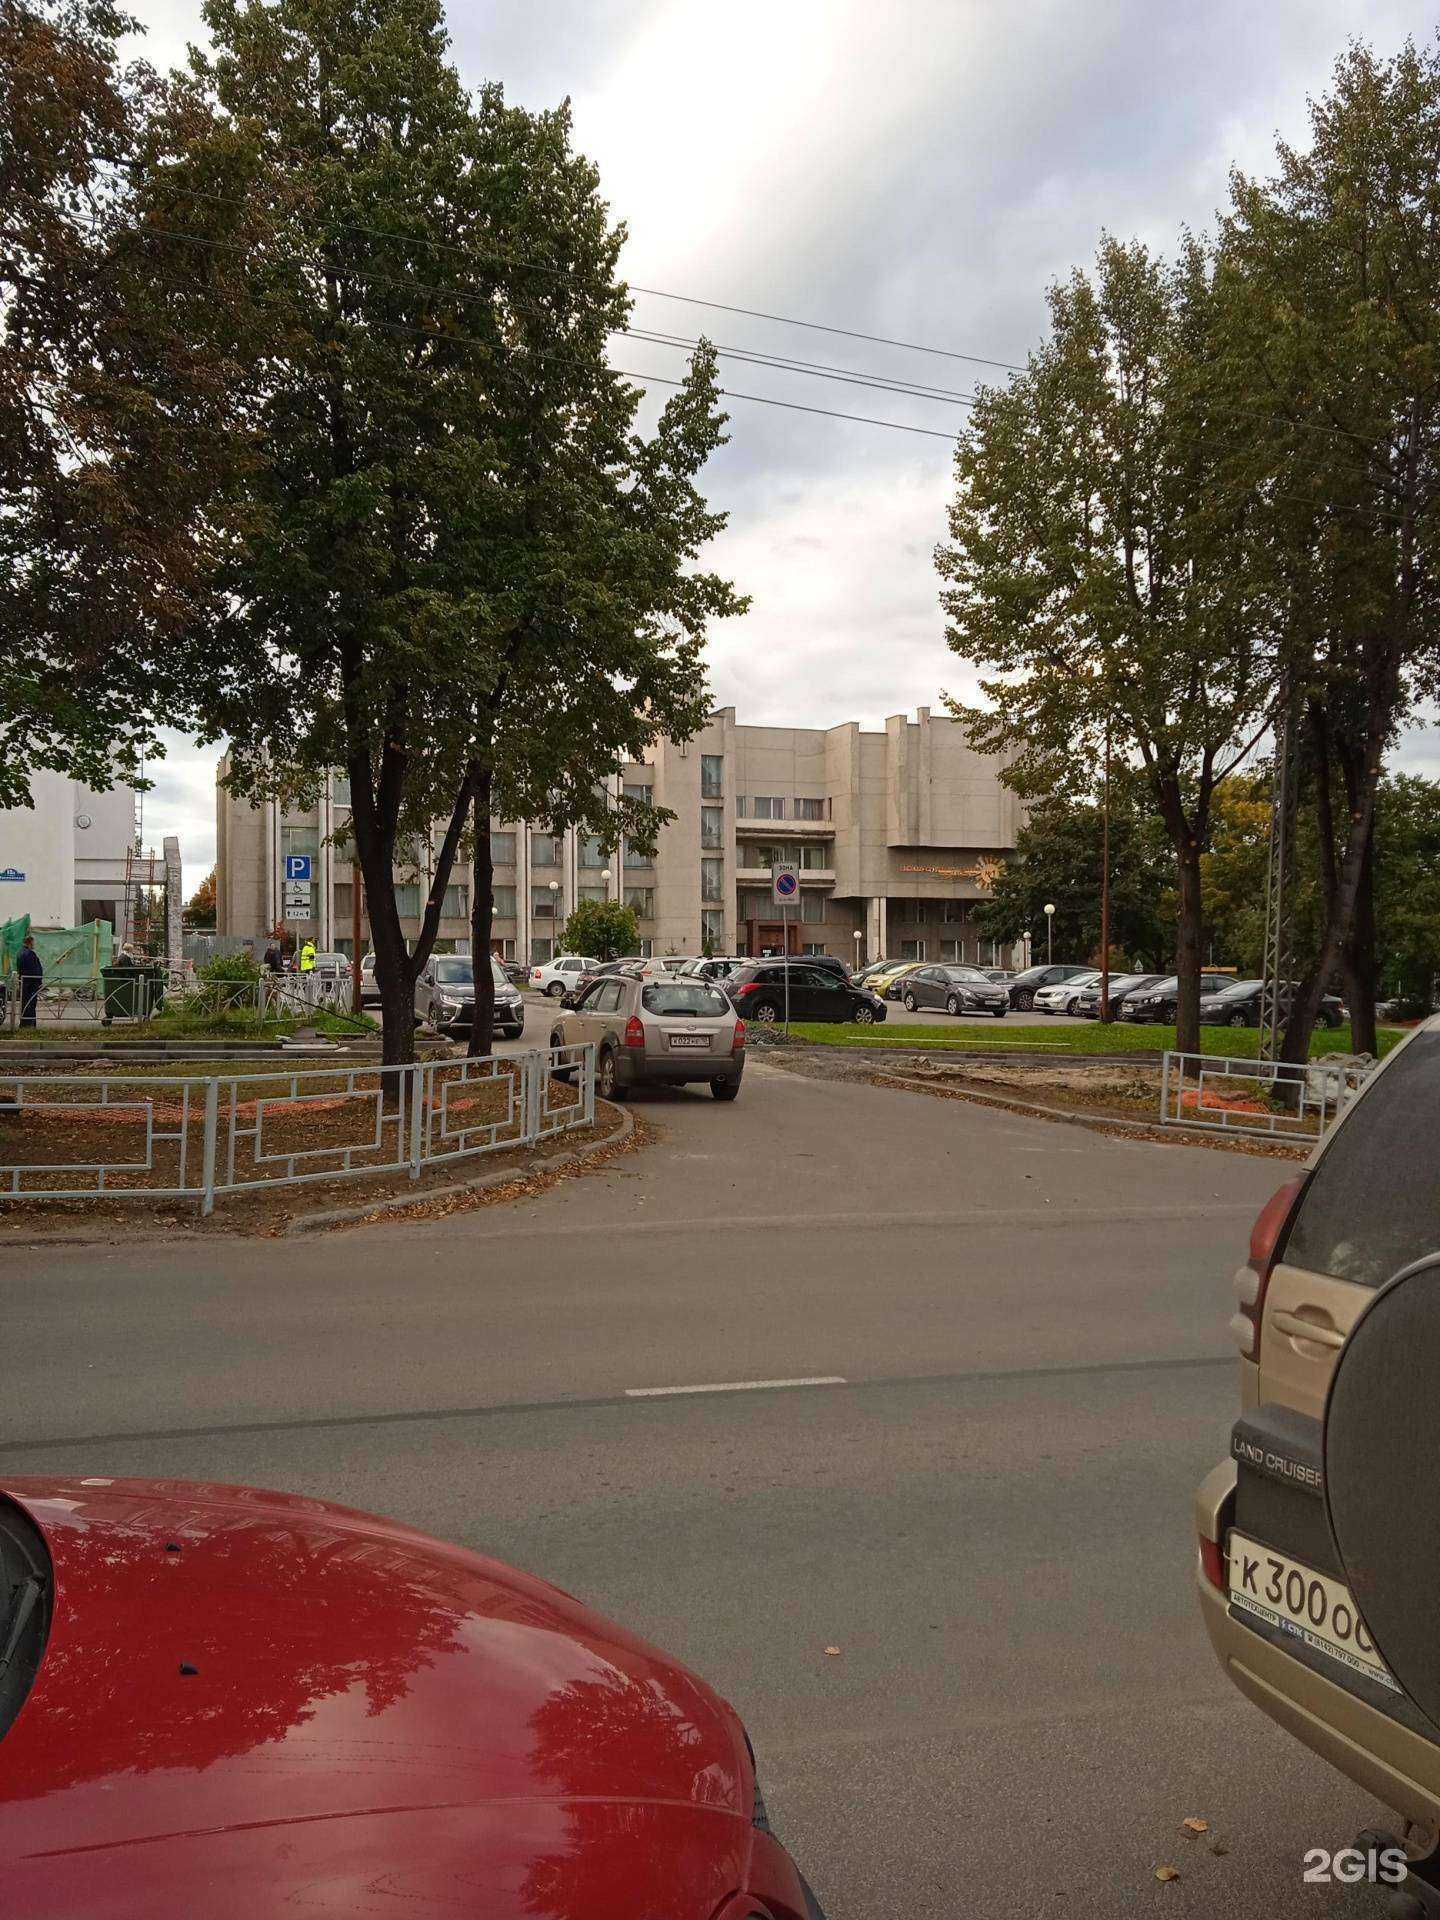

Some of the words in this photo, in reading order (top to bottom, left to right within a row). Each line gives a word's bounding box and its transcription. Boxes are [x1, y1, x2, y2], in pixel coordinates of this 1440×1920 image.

[292, 858, 305, 877] P
[1233, 1438, 1263, 1463] LAND
[1265, 1453, 1323, 1488] CRUISER
